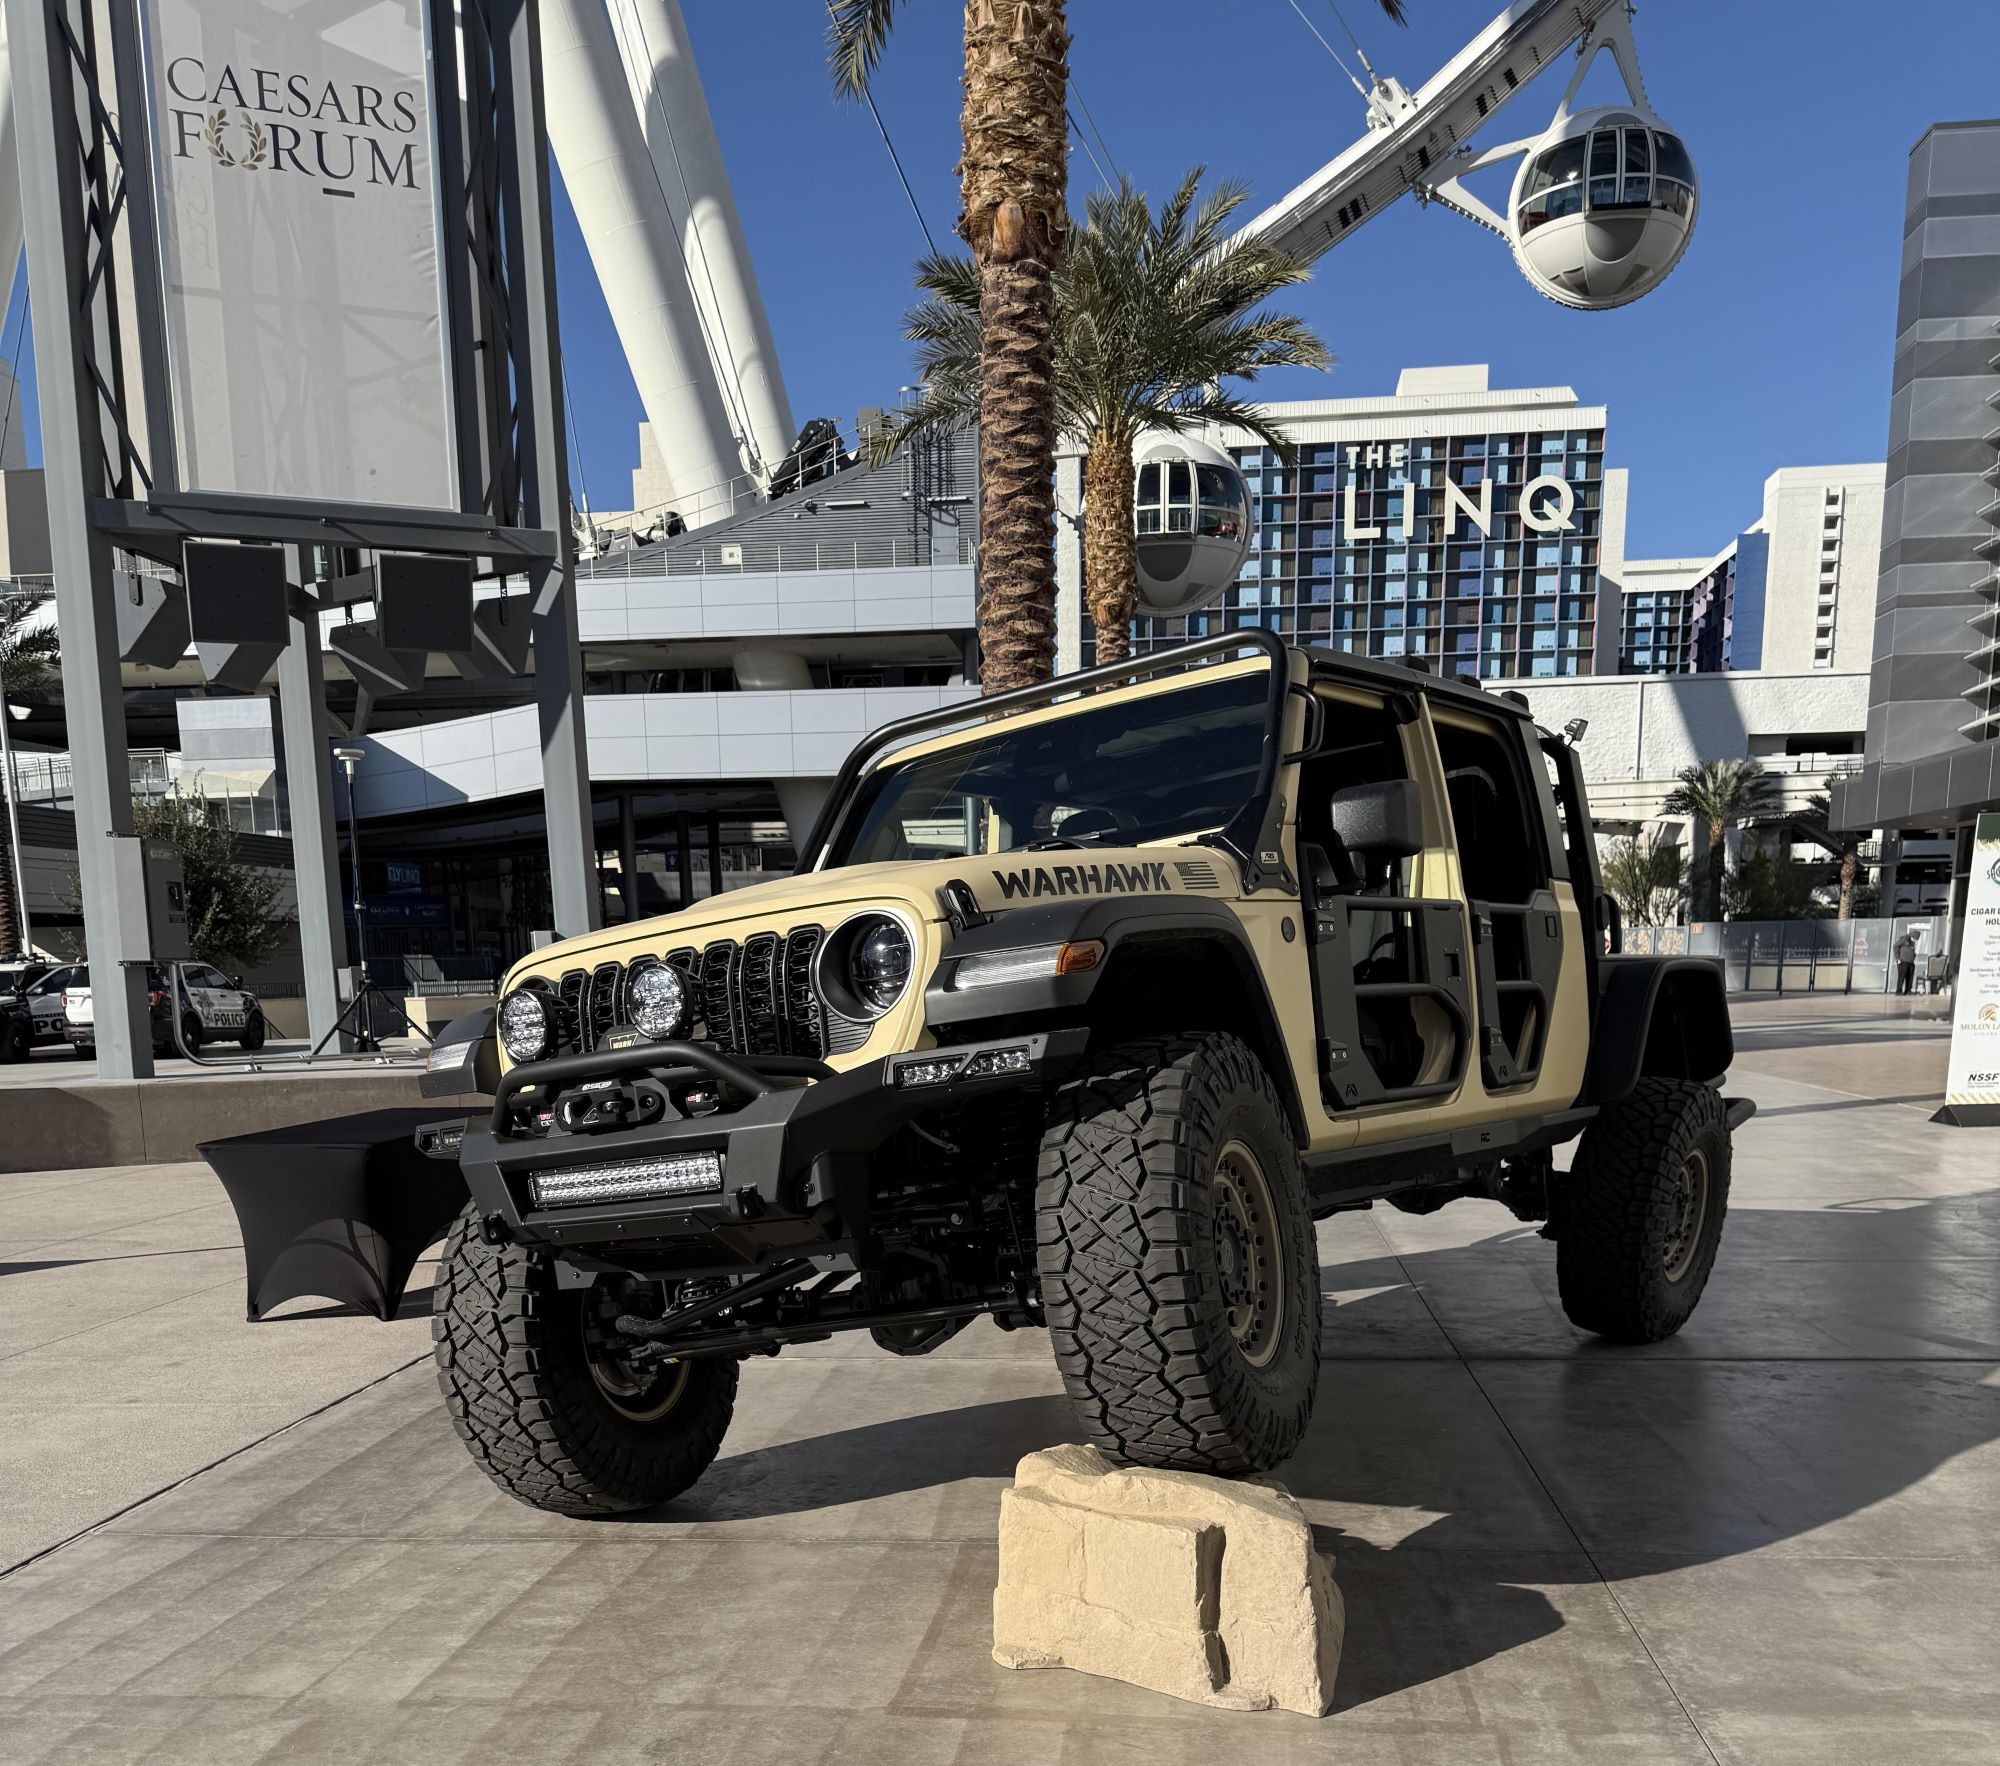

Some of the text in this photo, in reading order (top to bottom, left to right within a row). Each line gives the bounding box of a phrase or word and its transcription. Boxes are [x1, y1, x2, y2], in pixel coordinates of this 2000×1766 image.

[167, 57, 417, 134] CAESARS
[1345, 444, 1405, 470] THE
[1343, 474, 1576, 540] LINQ
[991, 861, 1172, 899] WARHAWK
[1971, 907, 1996, 916] CIGAR
[213, 1013, 245, 1026] POLICE
[1968, 1072, 2000, 1082] NSSF
